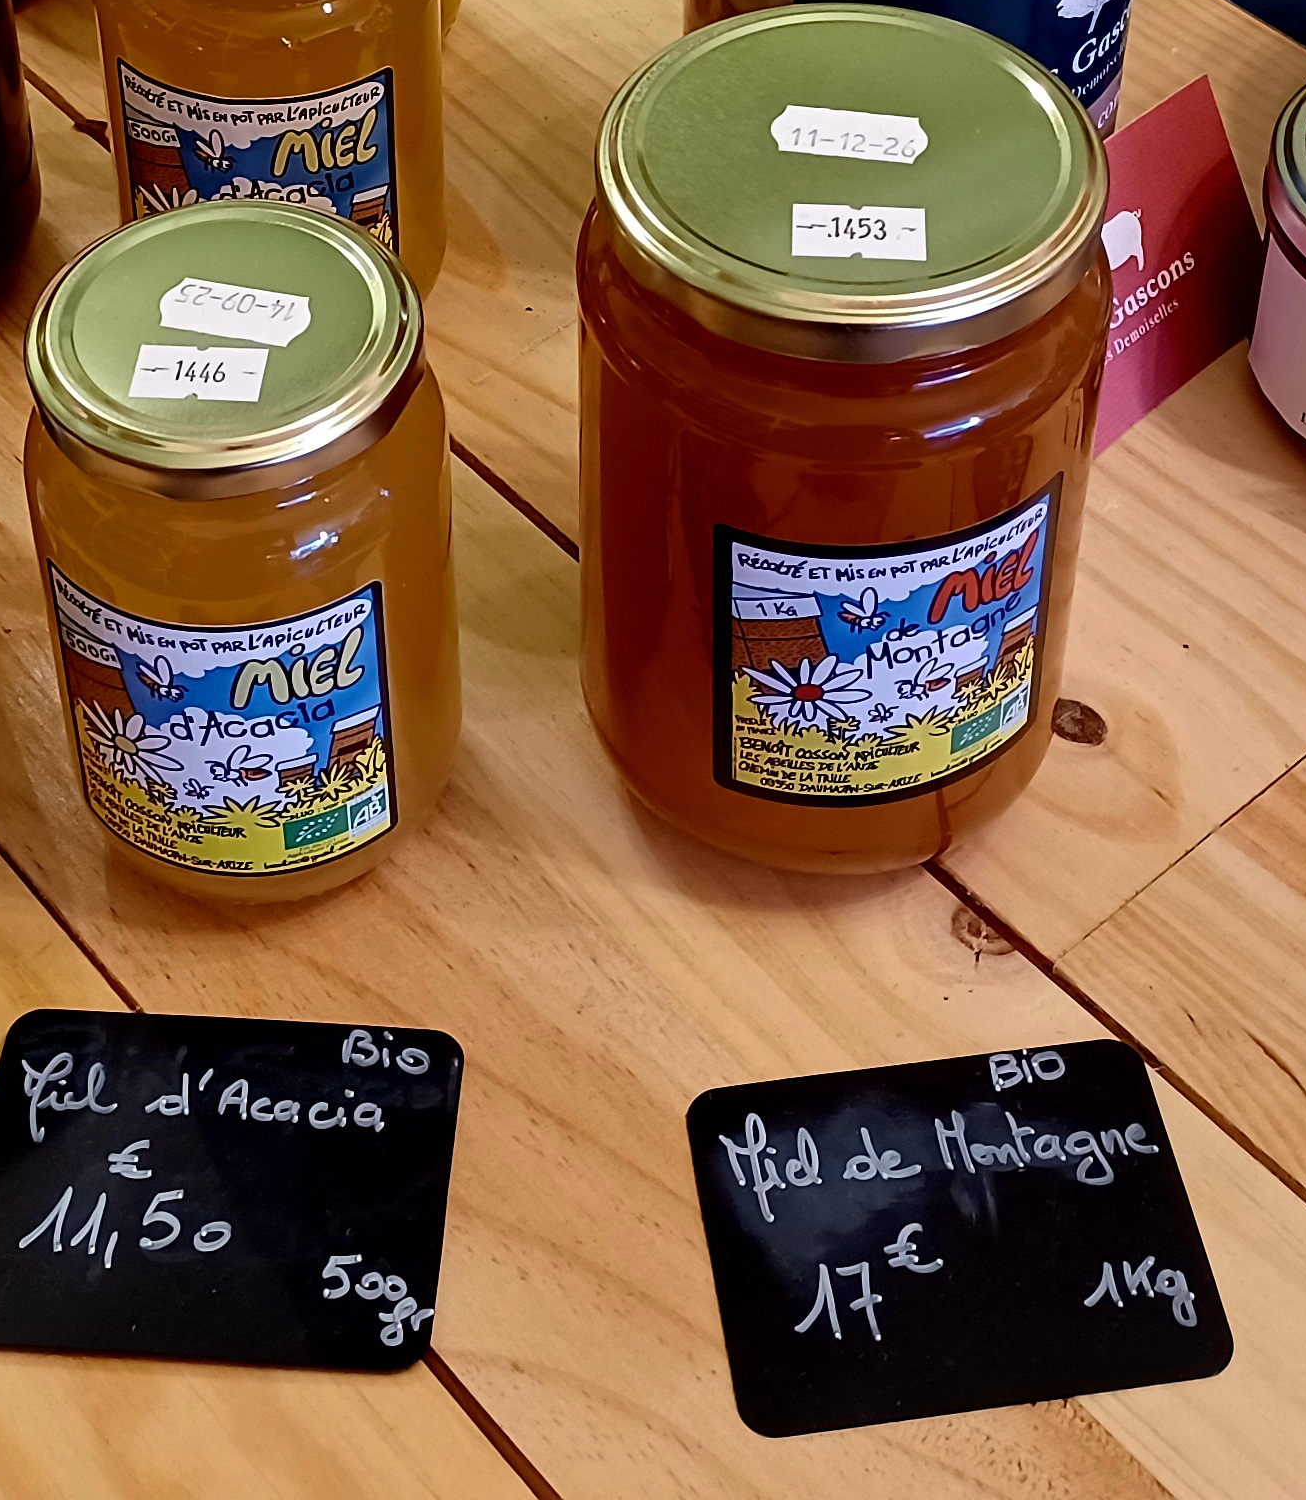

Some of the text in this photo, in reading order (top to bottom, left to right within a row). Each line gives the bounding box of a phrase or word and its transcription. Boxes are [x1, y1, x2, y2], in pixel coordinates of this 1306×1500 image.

[212, 110, 285, 125] EN POT PAR
[791, 128, 917, 158] 11-12-26
[832, 217, 887, 241] 1453
[174, 283, 295, 322] 14-09-25
[1109, 251, 1195, 329] Gascons
[1113, 298, 1180, 356] Demoiselles
[174, 360, 226, 383] 1446
[808, 554, 949, 580] ET EN POT PAR
[105, 619, 246, 653] ET EN POT PAR
[864, 592, 1023, 680] Montagne
[885, 621, 921, 643] de
[169, 699, 336, 746] d'Acacia
[352, 797, 383, 830] AB
[342, 1030, 431, 1075] Bio
[989, 1049, 1066, 1092] Bio
[22, 1052, 385, 1142] Miel d'Acacia
[108, 1140, 152, 1178] €
[719, 1110, 1159, 1223] Miel de Montagne
[19, 1186, 232, 1268] 11,50
[323, 1255, 407, 1301] 500
[794, 1223, 944, 1341] 17 €
[1084, 1256, 1198, 1327] 1Kg
[379, 1297, 434, 1347] gr
